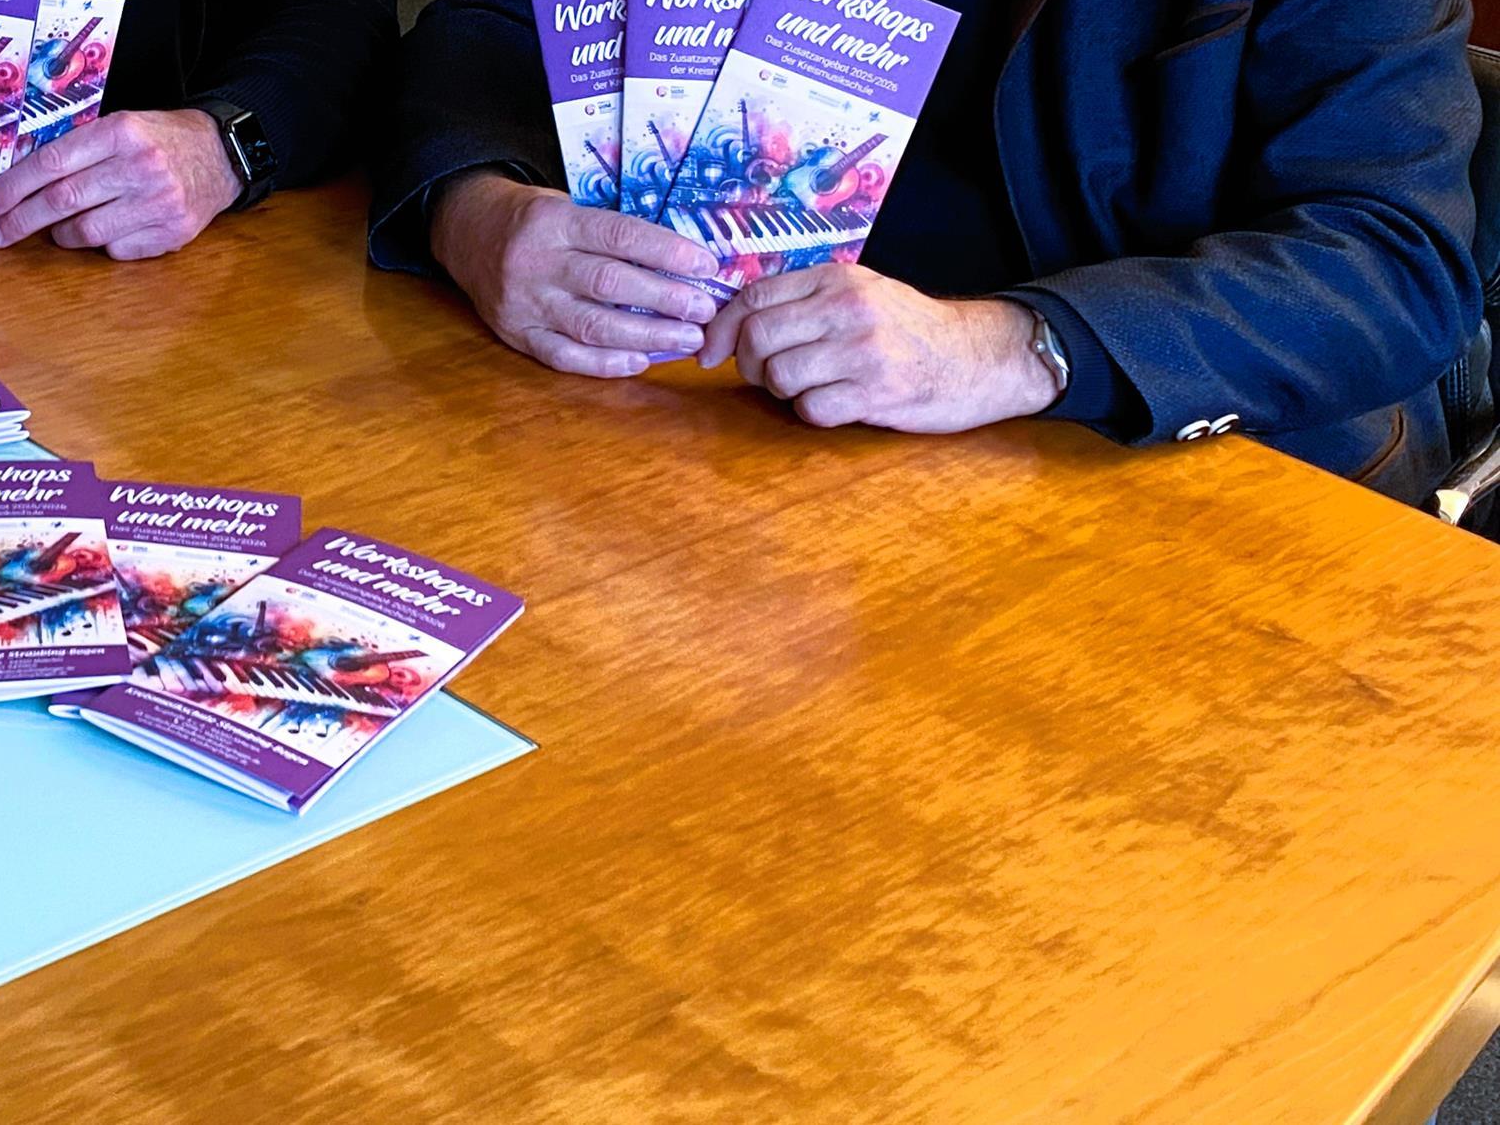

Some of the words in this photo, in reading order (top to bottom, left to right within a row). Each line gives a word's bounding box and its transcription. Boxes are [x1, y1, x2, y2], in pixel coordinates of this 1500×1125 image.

[571, 31, 624, 67] und
[654, 20, 716, 47] und
[776, 8, 842, 47] und
[831, 33, 910, 72] mehr
[649, 52, 668, 63] Das
[670, 65, 687, 75] der
[765, 34, 783, 49] Das
[783, 41, 851, 74] Zusatzangebot
[850, 67, 898, 92] 2025/2026
[570, 73, 589, 84] Das
[593, 80, 608, 91] der
[780, 54, 797, 66] der
[797, 59, 874, 96] Kreismusikschule
[109, 485, 279, 518] Workshops
[116, 510, 183, 528] und
[181, 516, 267, 536] mehr
[312, 559, 385, 585] und
[372, 580, 461, 616] mehr
[324, 536, 492, 607] Workshops
